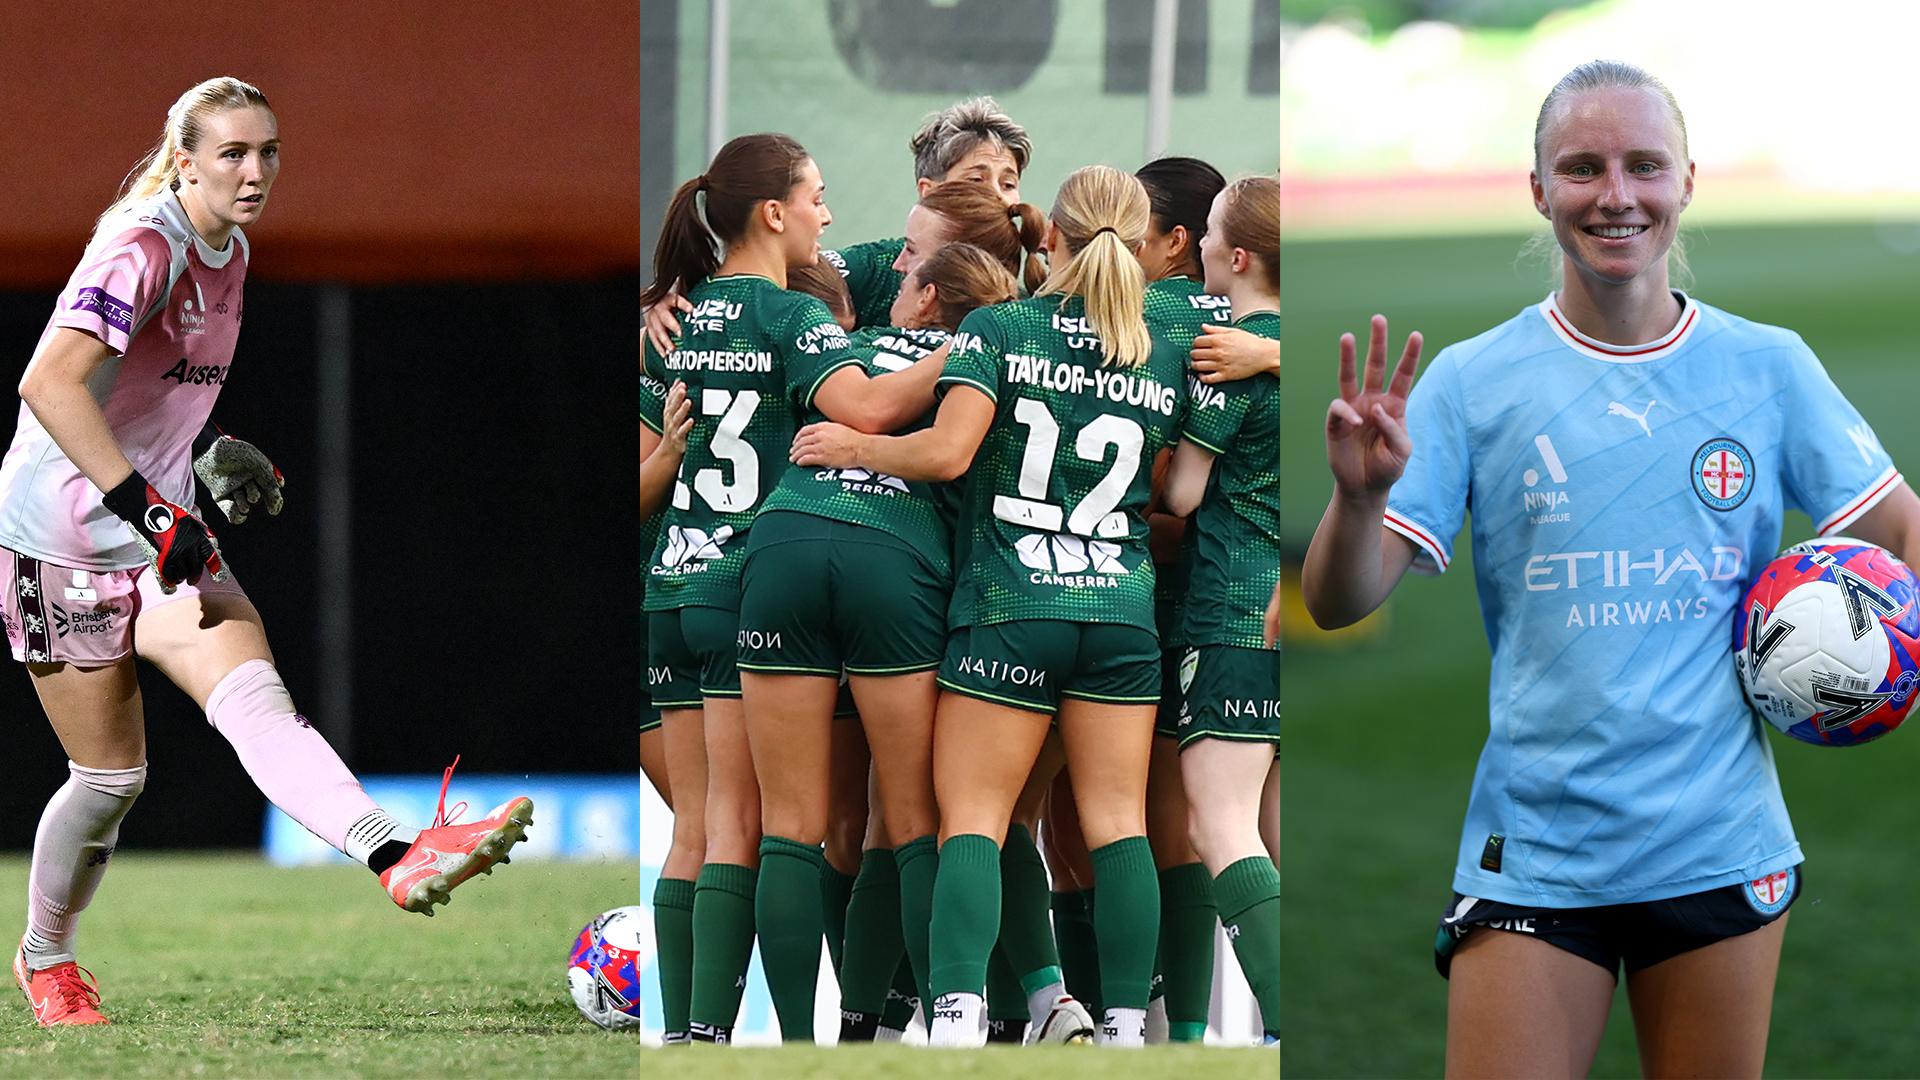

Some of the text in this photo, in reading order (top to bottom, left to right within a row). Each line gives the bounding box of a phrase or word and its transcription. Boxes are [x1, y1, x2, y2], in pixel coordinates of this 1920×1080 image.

[1188, 294, 1232, 309] ISU
[181, 312, 206, 327] NINJA
[1067, 336, 1102, 350] UT
[1005, 353, 1177, 416] TAYLOR-YOUNG
[1699, 441, 1737, 461] MELBOURNE
[993, 397, 1145, 537] 12
[1524, 490, 1569, 512] NINJA
[1701, 489, 1731, 507] FOOTBALL
[1524, 546, 1743, 592] ETIHAD
[1030, 572, 1119, 588] CANBERRA
[71, 606, 121, 623] Brisbane
[1566, 596, 1709, 628] AIRWAYS
[73, 620, 114, 635] Airport
[958, 656, 1046, 687] NATION
